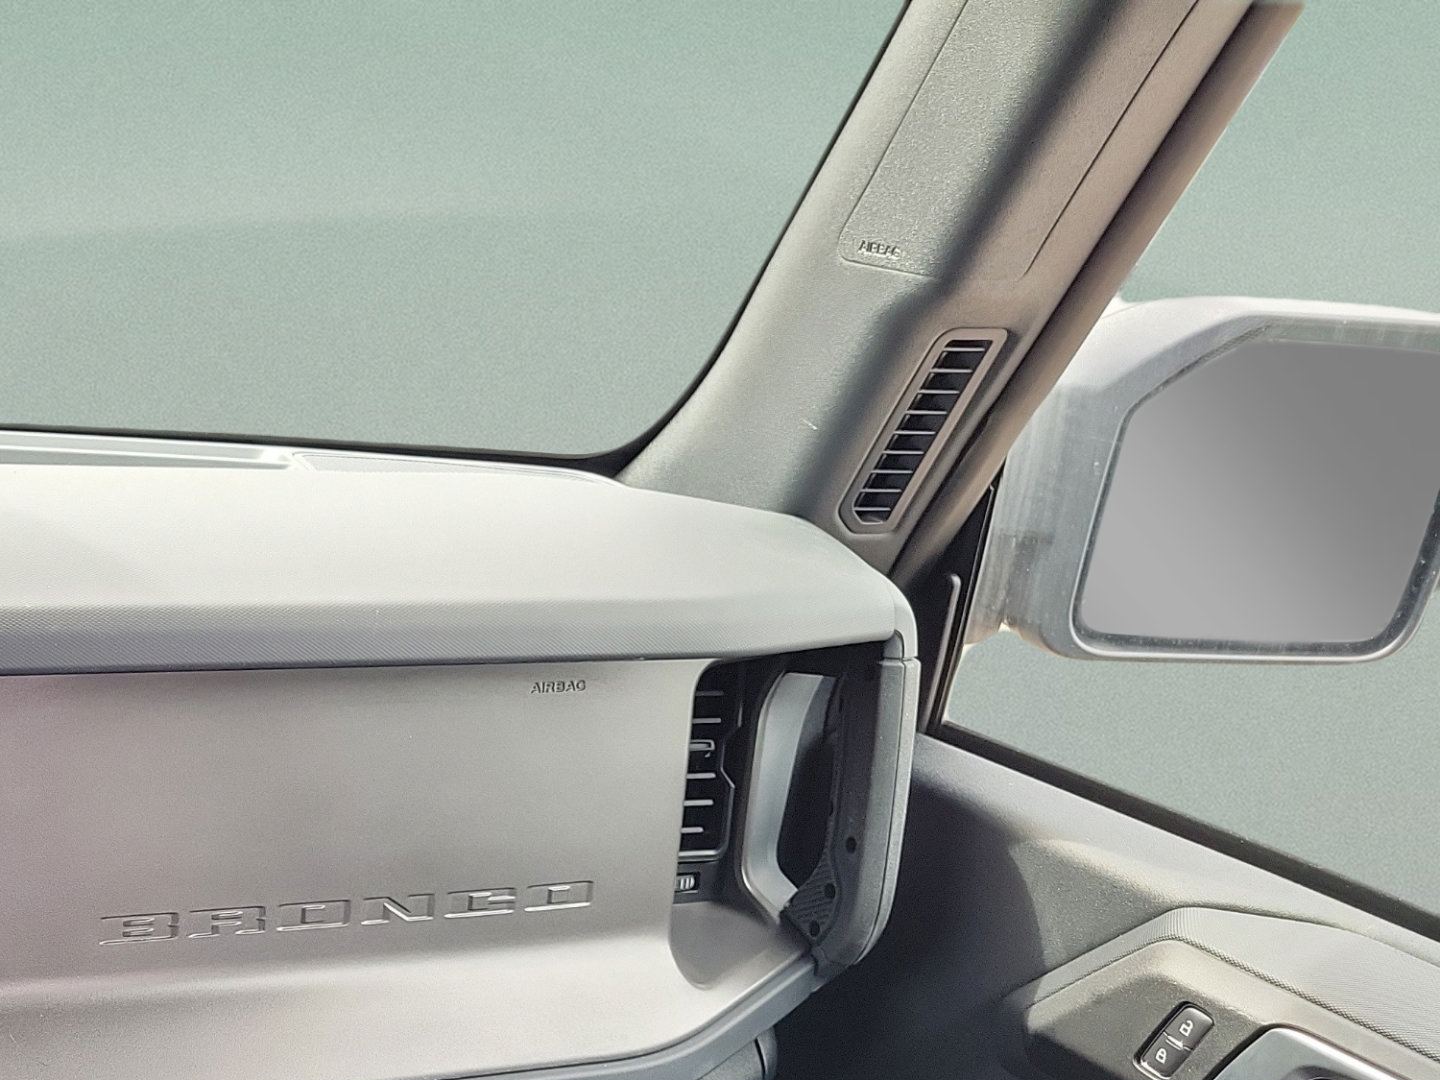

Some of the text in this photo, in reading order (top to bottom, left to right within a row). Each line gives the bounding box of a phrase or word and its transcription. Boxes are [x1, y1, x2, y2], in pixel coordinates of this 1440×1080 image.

[858, 239, 900, 258] AIRBAG
[530, 679, 587, 694] AIRBAG
[99, 880, 594, 945] BRONCO
